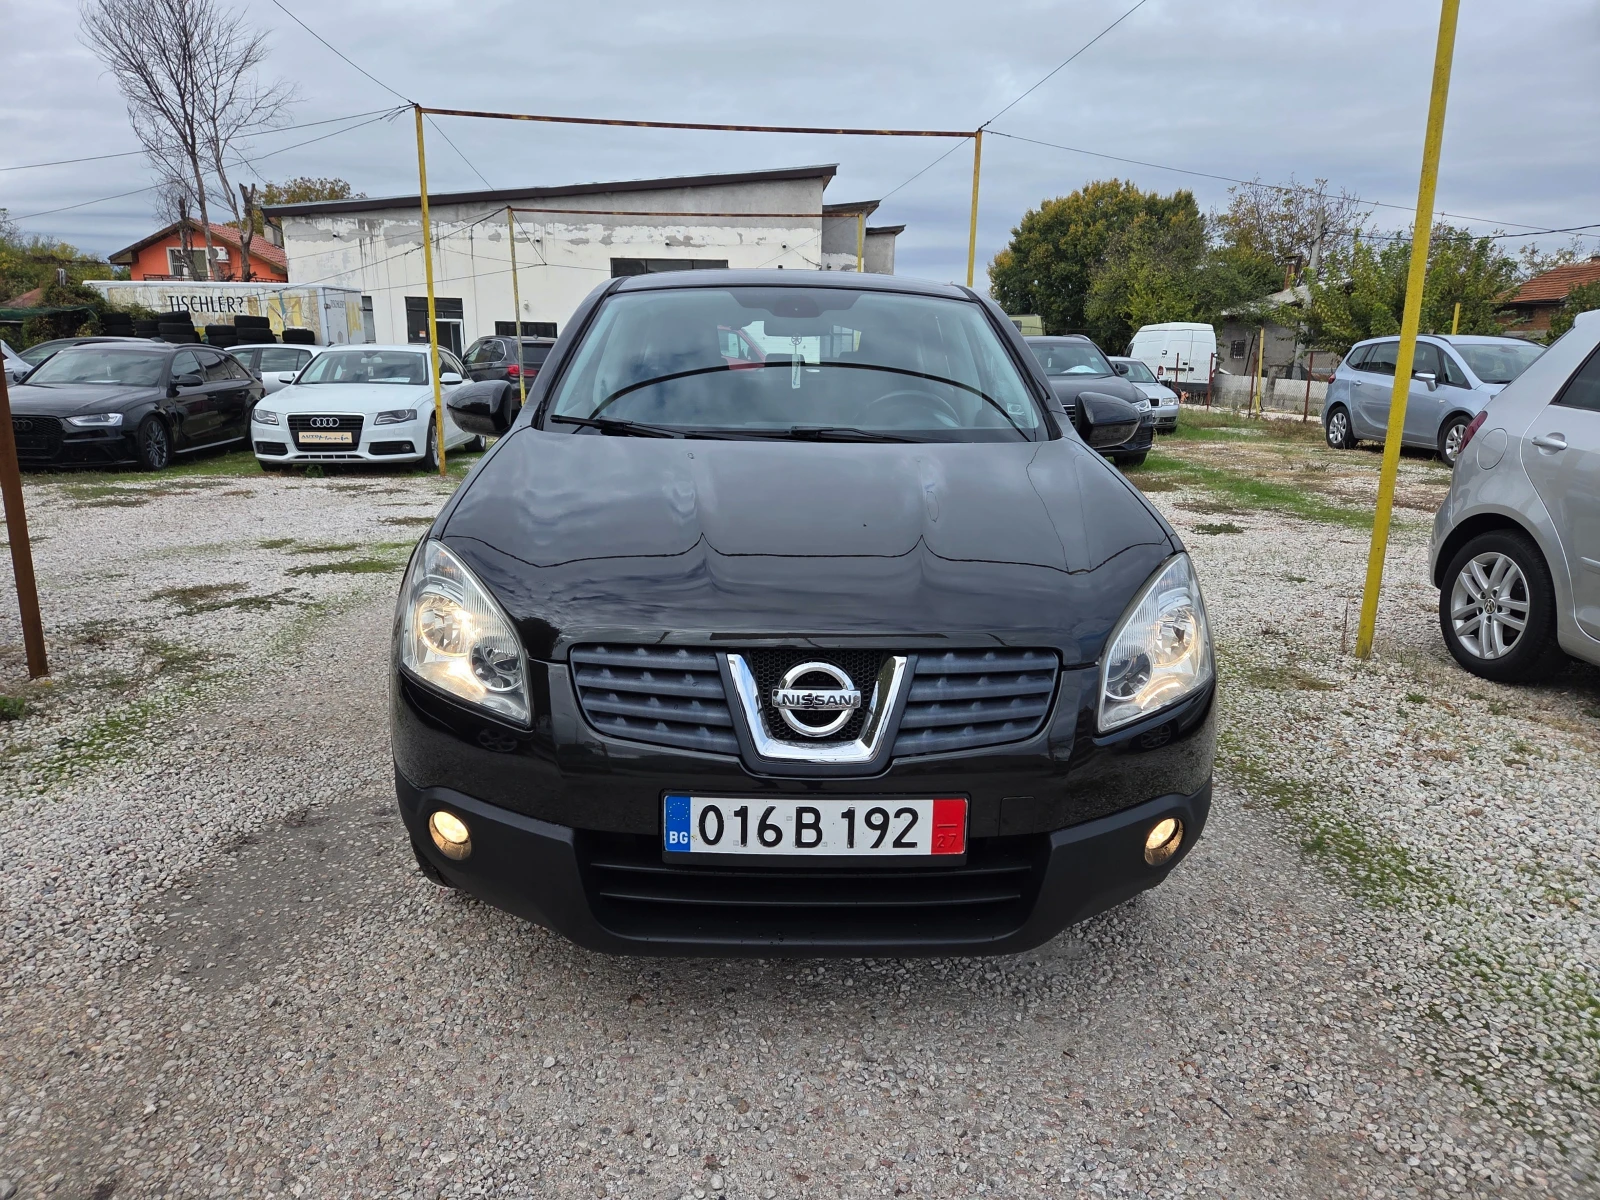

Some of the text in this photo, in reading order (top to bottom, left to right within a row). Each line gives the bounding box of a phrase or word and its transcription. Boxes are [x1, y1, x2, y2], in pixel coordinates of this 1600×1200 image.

[168, 296, 243, 313] TISCHLER?
[782, 693, 852, 706] NISSAN
[669, 831, 689, 844] BG
